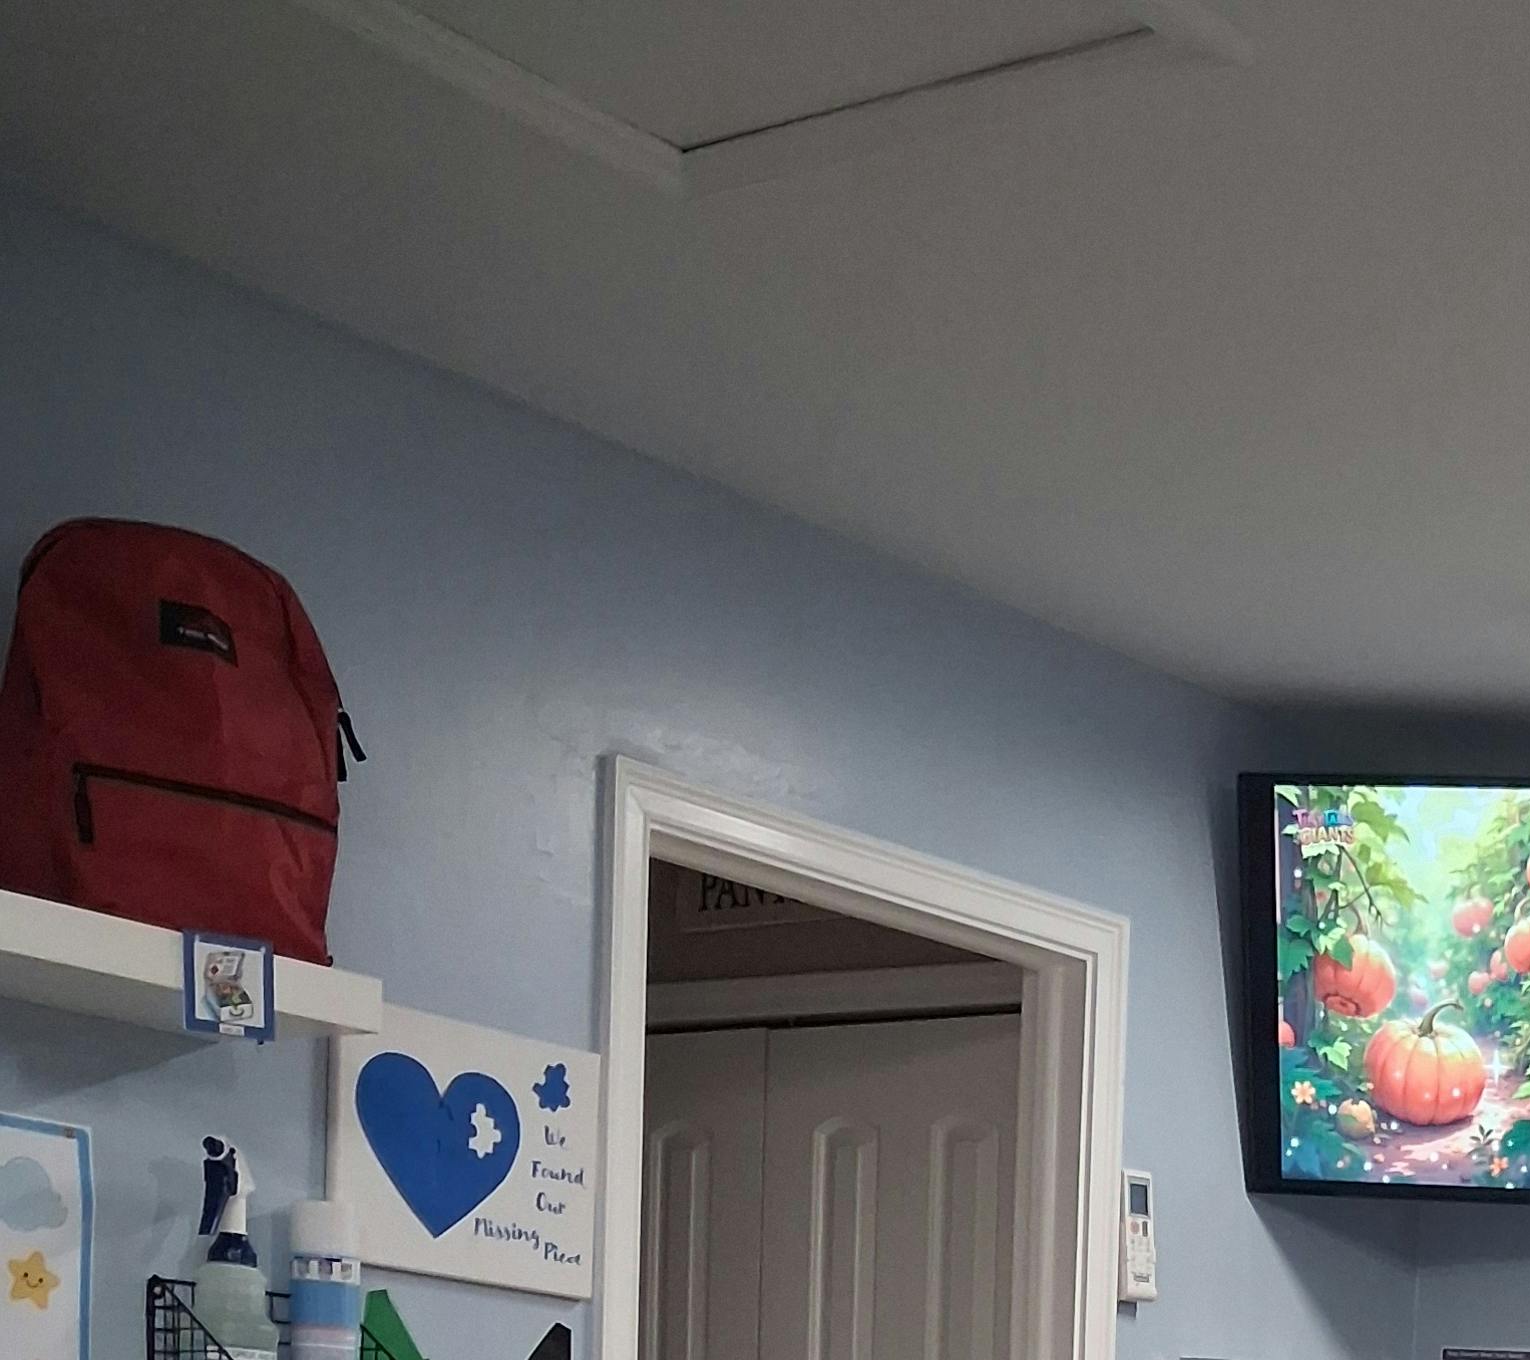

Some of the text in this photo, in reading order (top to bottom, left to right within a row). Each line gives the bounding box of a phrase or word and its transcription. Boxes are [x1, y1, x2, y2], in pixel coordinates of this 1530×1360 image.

[544, 1125, 567, 1150] We
[531, 1160, 585, 1187] Found
[536, 1191, 567, 1215] Our
[474, 1216, 540, 1250] Missing
